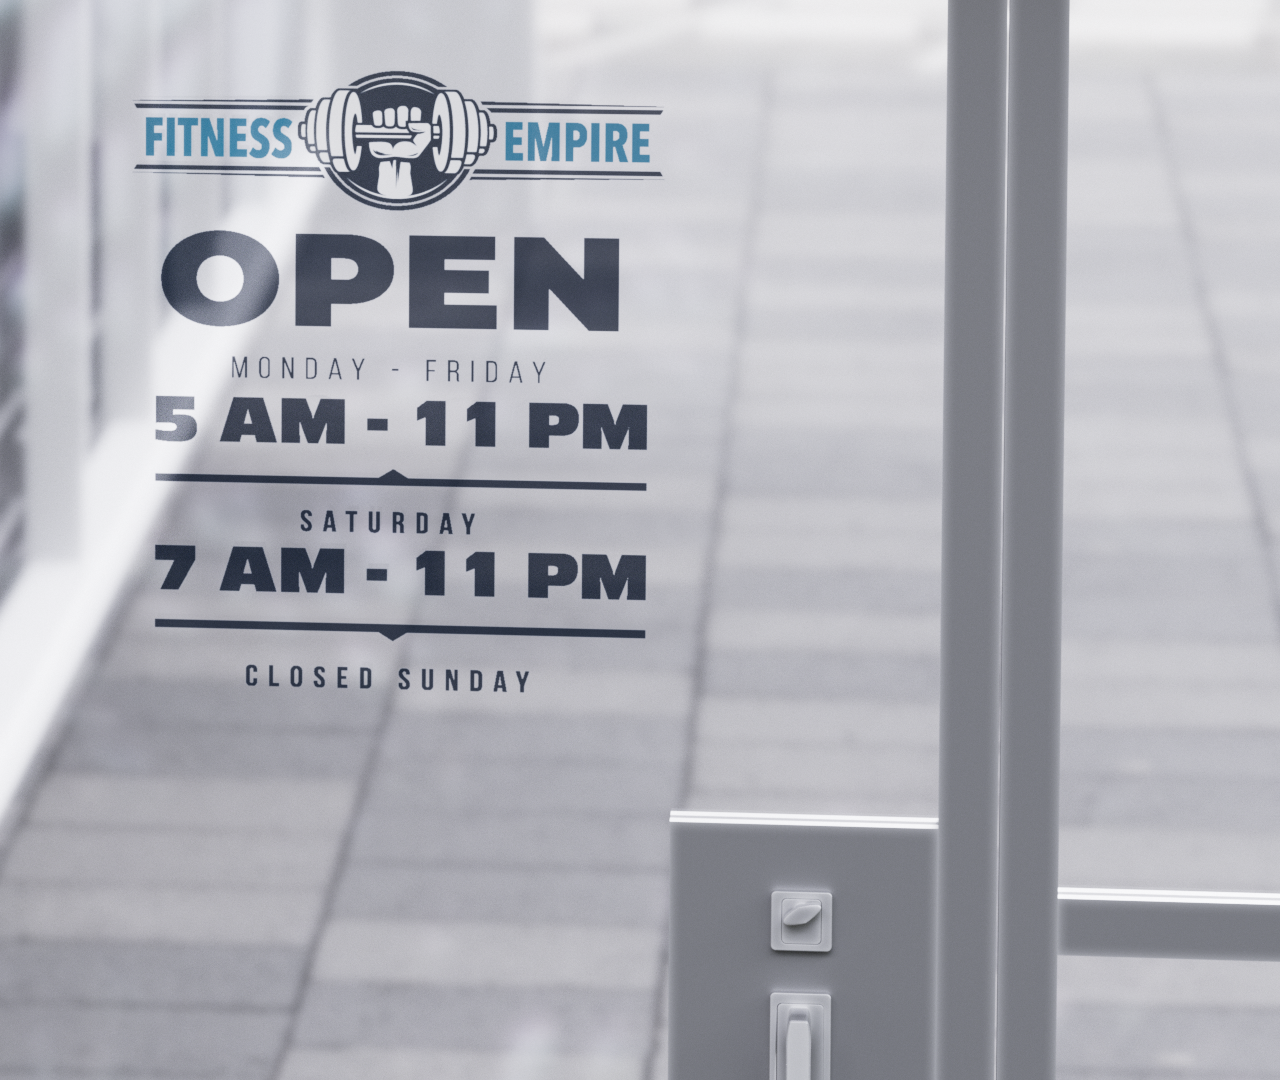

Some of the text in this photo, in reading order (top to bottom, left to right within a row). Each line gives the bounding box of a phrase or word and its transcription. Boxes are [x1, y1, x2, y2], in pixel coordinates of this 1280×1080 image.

[145, 117, 651, 163] FITNESS EMPIRE
[160, 230, 620, 332] OPEN
[231, 356, 366, 381] MONDAY
[425, 359, 547, 384] FRIDAY
[155, 395, 648, 451] 5 AM - 11 PM
[300, 509, 477, 536] SATURDAY
[154, 544, 647, 601] 7 AM - 11 PM
[245, 664, 531, 693] CLOSED SUNDAY
